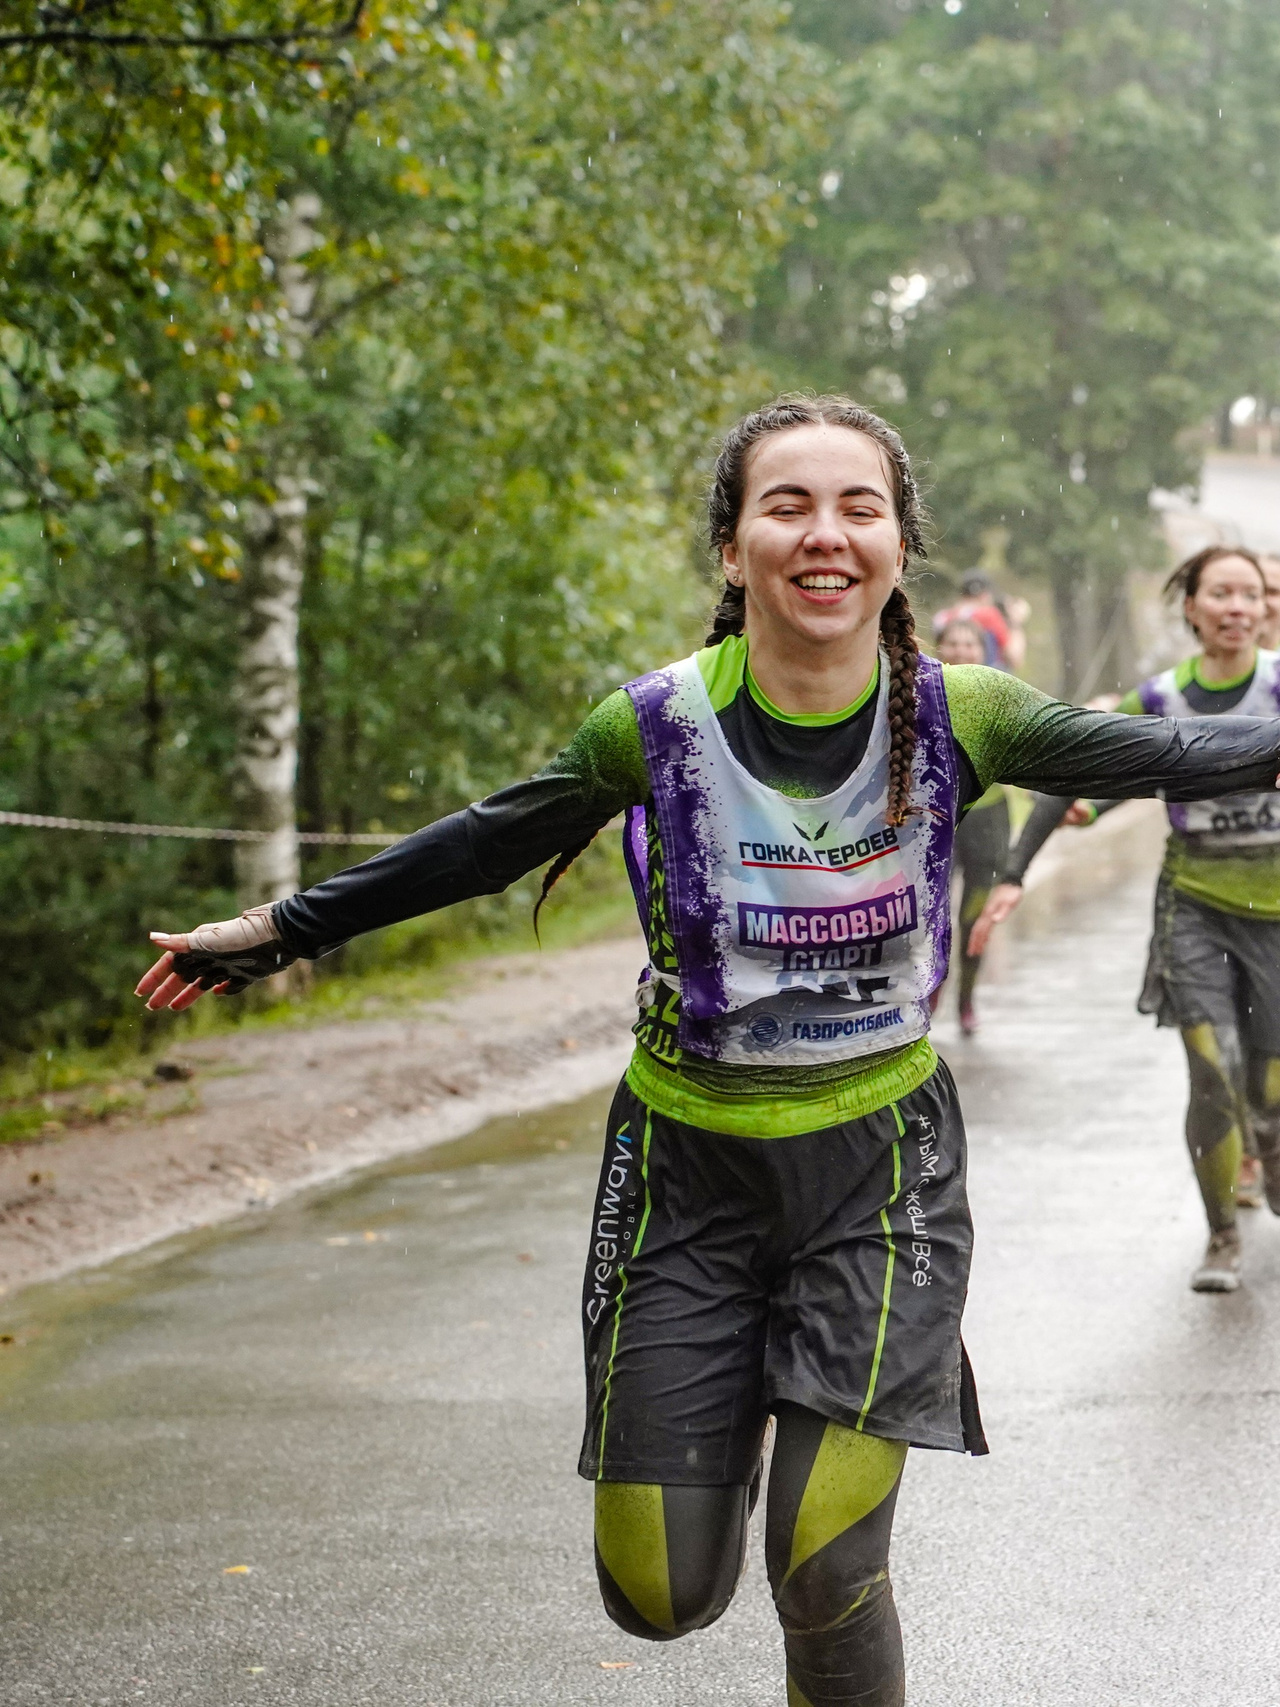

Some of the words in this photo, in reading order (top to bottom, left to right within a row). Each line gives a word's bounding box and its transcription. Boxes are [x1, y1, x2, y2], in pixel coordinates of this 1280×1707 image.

[739, 842, 812, 863] ГОНКА
[814, 827, 898, 866] ГЕРОЕВ
[745, 886, 912, 944] МАССОВЫЙ
[789, 943, 877, 970] СТАРТ
[792, 1008, 904, 1040] ГАЗПРОМБАНК
